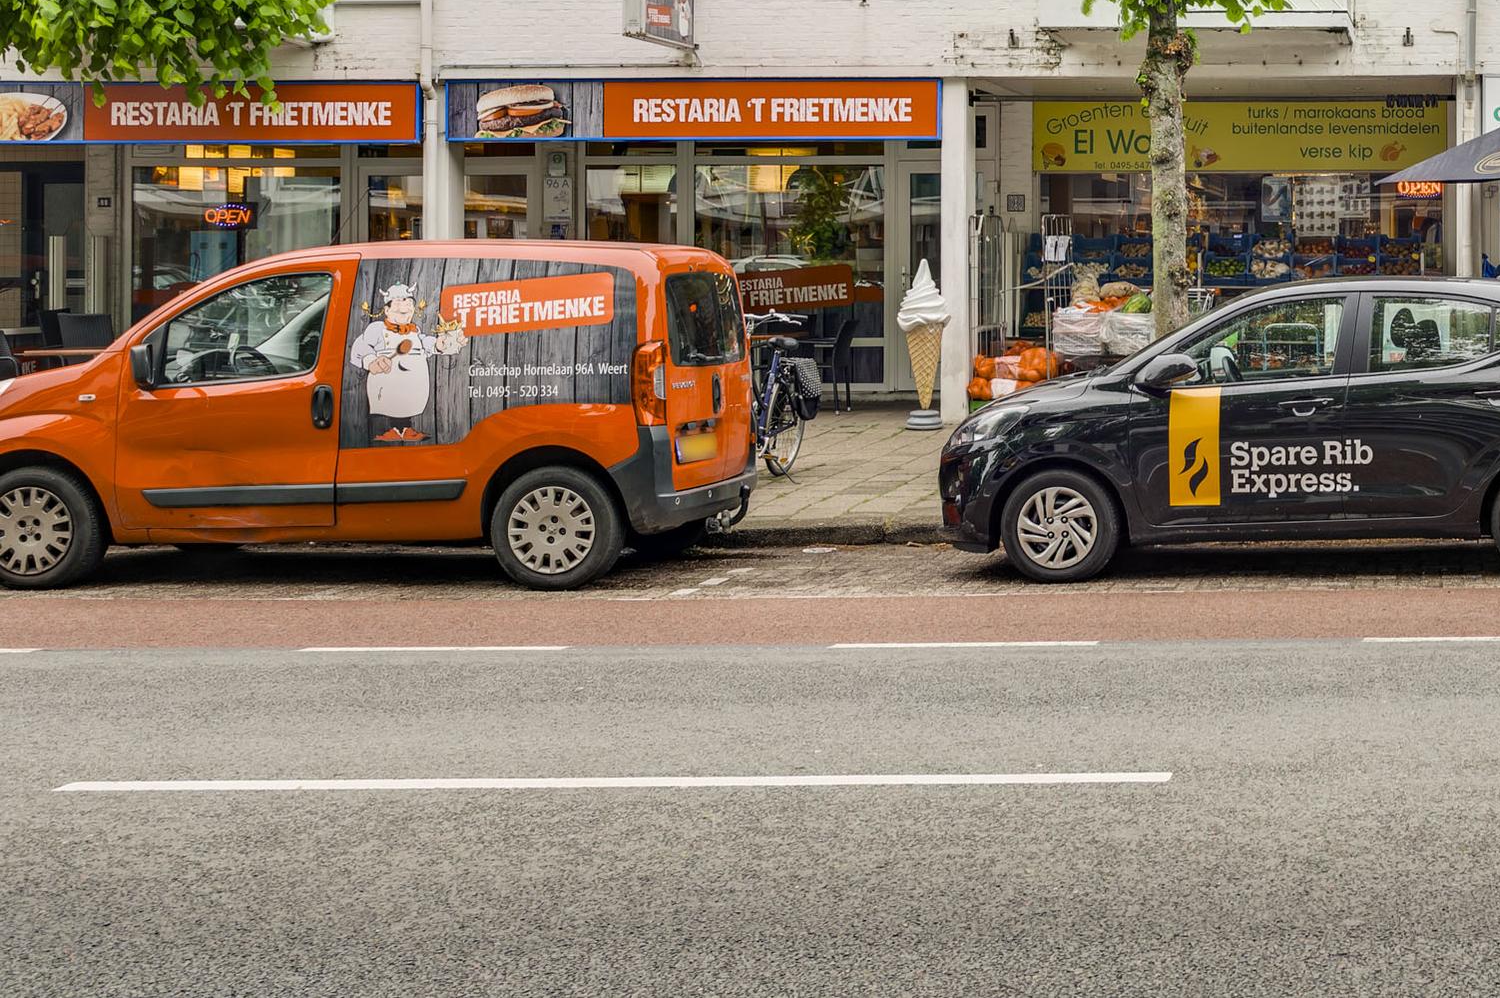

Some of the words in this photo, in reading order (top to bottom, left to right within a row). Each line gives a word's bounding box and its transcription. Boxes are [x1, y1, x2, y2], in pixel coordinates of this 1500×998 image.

[111, 102, 220, 126] RESTARIA
[250, 102, 392, 126] FRIETMENKE
[633, 98, 741, 122] RESTARIA
[771, 98, 912, 122] FRIETMENKE
[1046, 102, 1133, 135] Groenten
[1248, 106, 1279, 119] turks
[1284, 106, 1289, 120] /
[1293, 106, 1376, 119] marrokaans
[1381, 106, 1425, 119] brood
[1232, 122, 1324, 135] buitenlandse
[1328, 122, 1440, 135] levensmiddelen
[1074, 129, 1095, 155] El
[1106, 129, 1151, 155] Wa
[1300, 147, 1342, 158] verse
[1350, 144, 1373, 161] kip
[1110, 161, 1151, 170] 0495-547
[546, 179, 559, 189] 96
[562, 179, 569, 188] A
[1397, 182, 1441, 195] OPEN
[205, 209, 250, 224] OPEN
[740, 277, 784, 292] ESTARIA
[453, 289, 521, 309] RESTARIA
[750, 283, 848, 306] FRIETMENKE
[475, 296, 605, 327] FRIETMENKE
[468, 364, 521, 378] Graafschap
[524, 363, 573, 376] Hornelaan
[576, 363, 594, 375] 96A
[599, 363, 628, 375] Weert
[468, 386, 484, 398] Tel.
[486, 386, 510, 398] 0495
[520, 386, 538, 397] 520
[540, 385, 558, 397] 334
[1230, 441, 1317, 471] Spare
[1323, 439, 1373, 466] Rib
[1231, 469, 1360, 498] Express.
